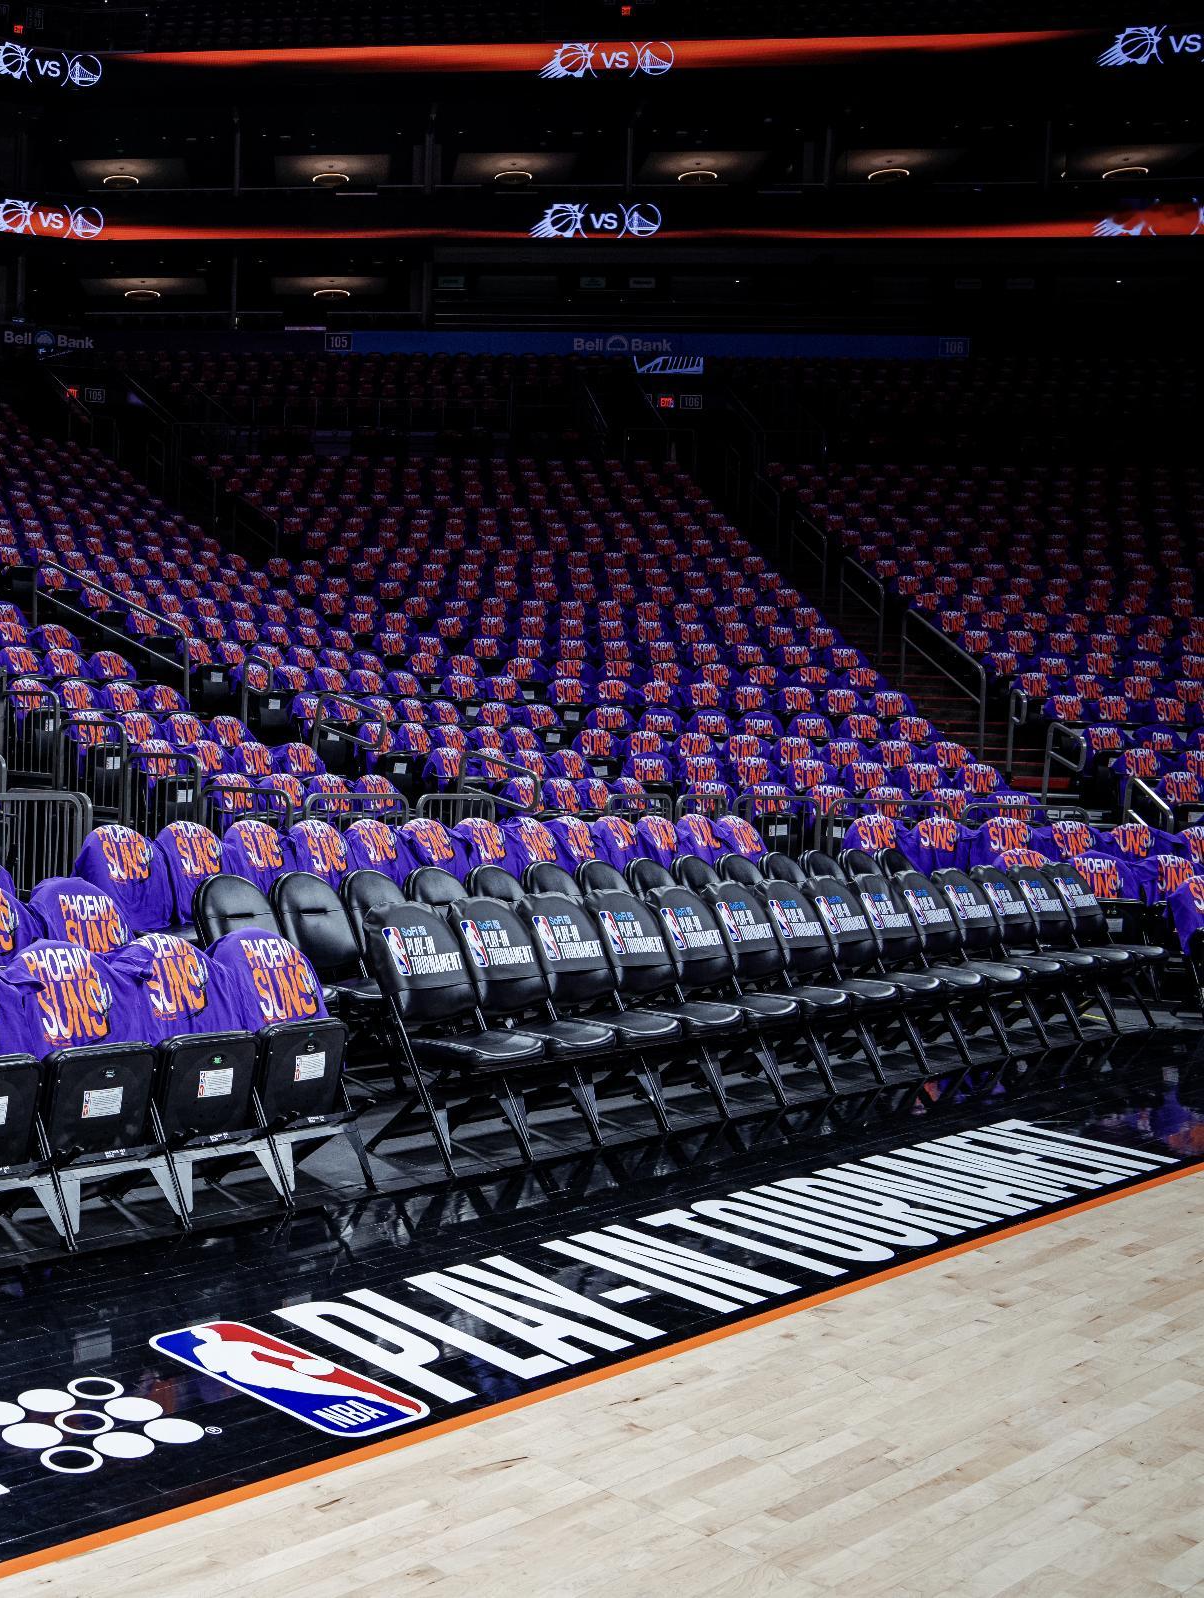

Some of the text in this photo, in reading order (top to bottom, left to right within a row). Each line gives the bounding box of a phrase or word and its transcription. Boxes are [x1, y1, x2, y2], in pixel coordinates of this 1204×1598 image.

[1168, 34, 1202, 53] VS
[36, 58, 60, 78] VS
[601, 51, 629, 69] VS
[38, 212, 64, 229] VS
[590, 213, 618, 230] VS
[4, 330, 95, 350] Bell Bank
[330, 335, 348, 350] 105
[573, 336, 672, 352] Bell Bank
[945, 340, 964, 354] 106
[90, 390, 102, 401] 105
[684, 396, 700, 408] 106
[857, 825, 896, 850] SUNS
[918, 824, 957, 852] SUNS
[988, 827, 1028, 850] SUNS
[102, 839, 150, 880] SUNS
[176, 836, 222, 874] SUNS
[240, 830, 283, 869] SUNS
[1074, 858, 1117, 874] PHOENIX
[58, 894, 120, 923] PHOENIX
[131, 932, 196, 959] OENIX
[240, 938, 304, 969] PHOENIX
[404, 936, 436, 954] PLAY-IN
[24, 947, 98, 983] PHOENIX
[410, 952, 462, 975] TOURNAMENT
[146, 953, 206, 1014] SUNS
[253, 960, 318, 1020] SUNS
[37, 978, 108, 1039] SUNS
[272, 1118, 1181, 1403] PLAY-IN TOURNAMENT
[313, 1398, 387, 1429] NBA
